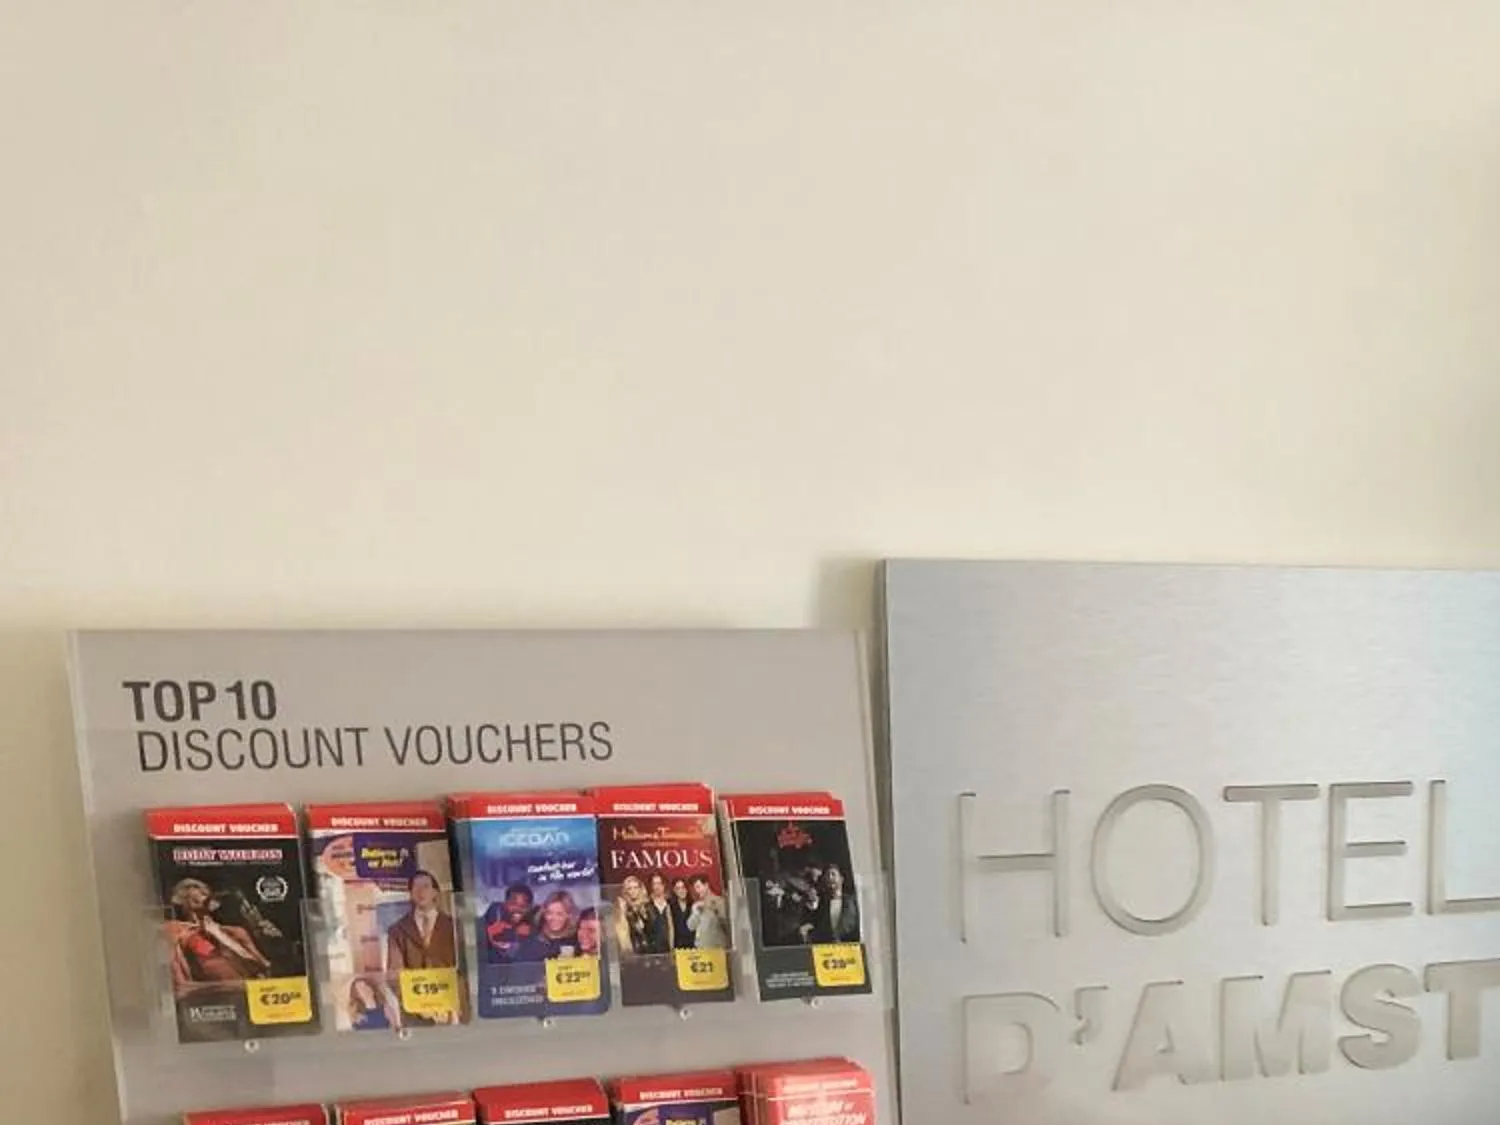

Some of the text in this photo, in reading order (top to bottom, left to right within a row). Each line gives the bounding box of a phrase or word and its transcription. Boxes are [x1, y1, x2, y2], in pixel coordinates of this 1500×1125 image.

[123, 680, 277, 723] TOP 10
[137, 721, 614, 773] DISCOUNT VOUCHERS
[610, 849, 714, 869] FAMOUS
